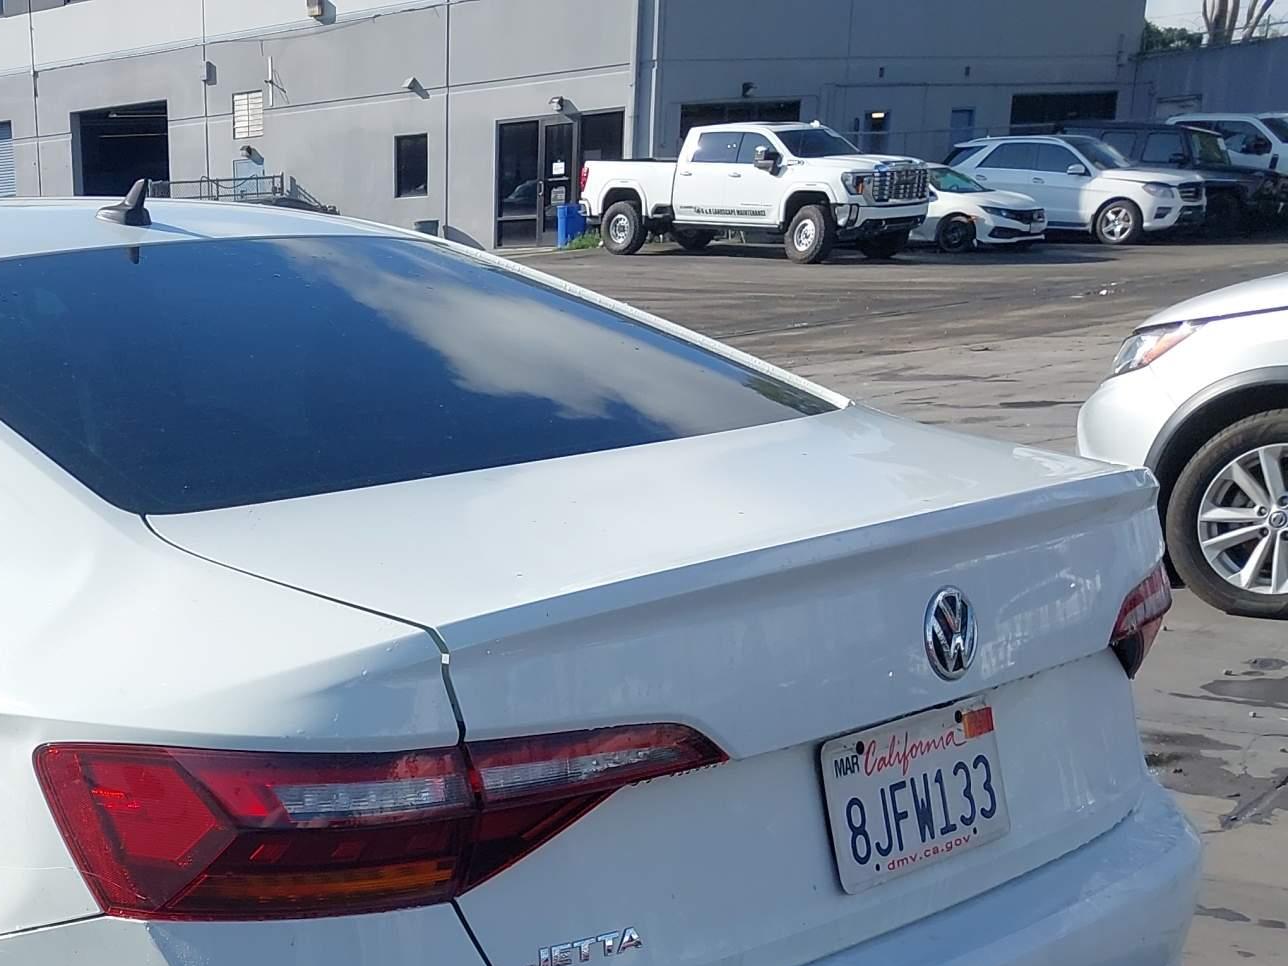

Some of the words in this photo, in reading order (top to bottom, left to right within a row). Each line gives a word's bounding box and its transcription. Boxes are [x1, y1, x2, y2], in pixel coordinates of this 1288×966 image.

[833, 754, 861, 779] MAR
[863, 730, 967, 777] California
[845, 754, 997, 865] 8JFW133
[887, 833, 972, 871] dmv.ca.gov
